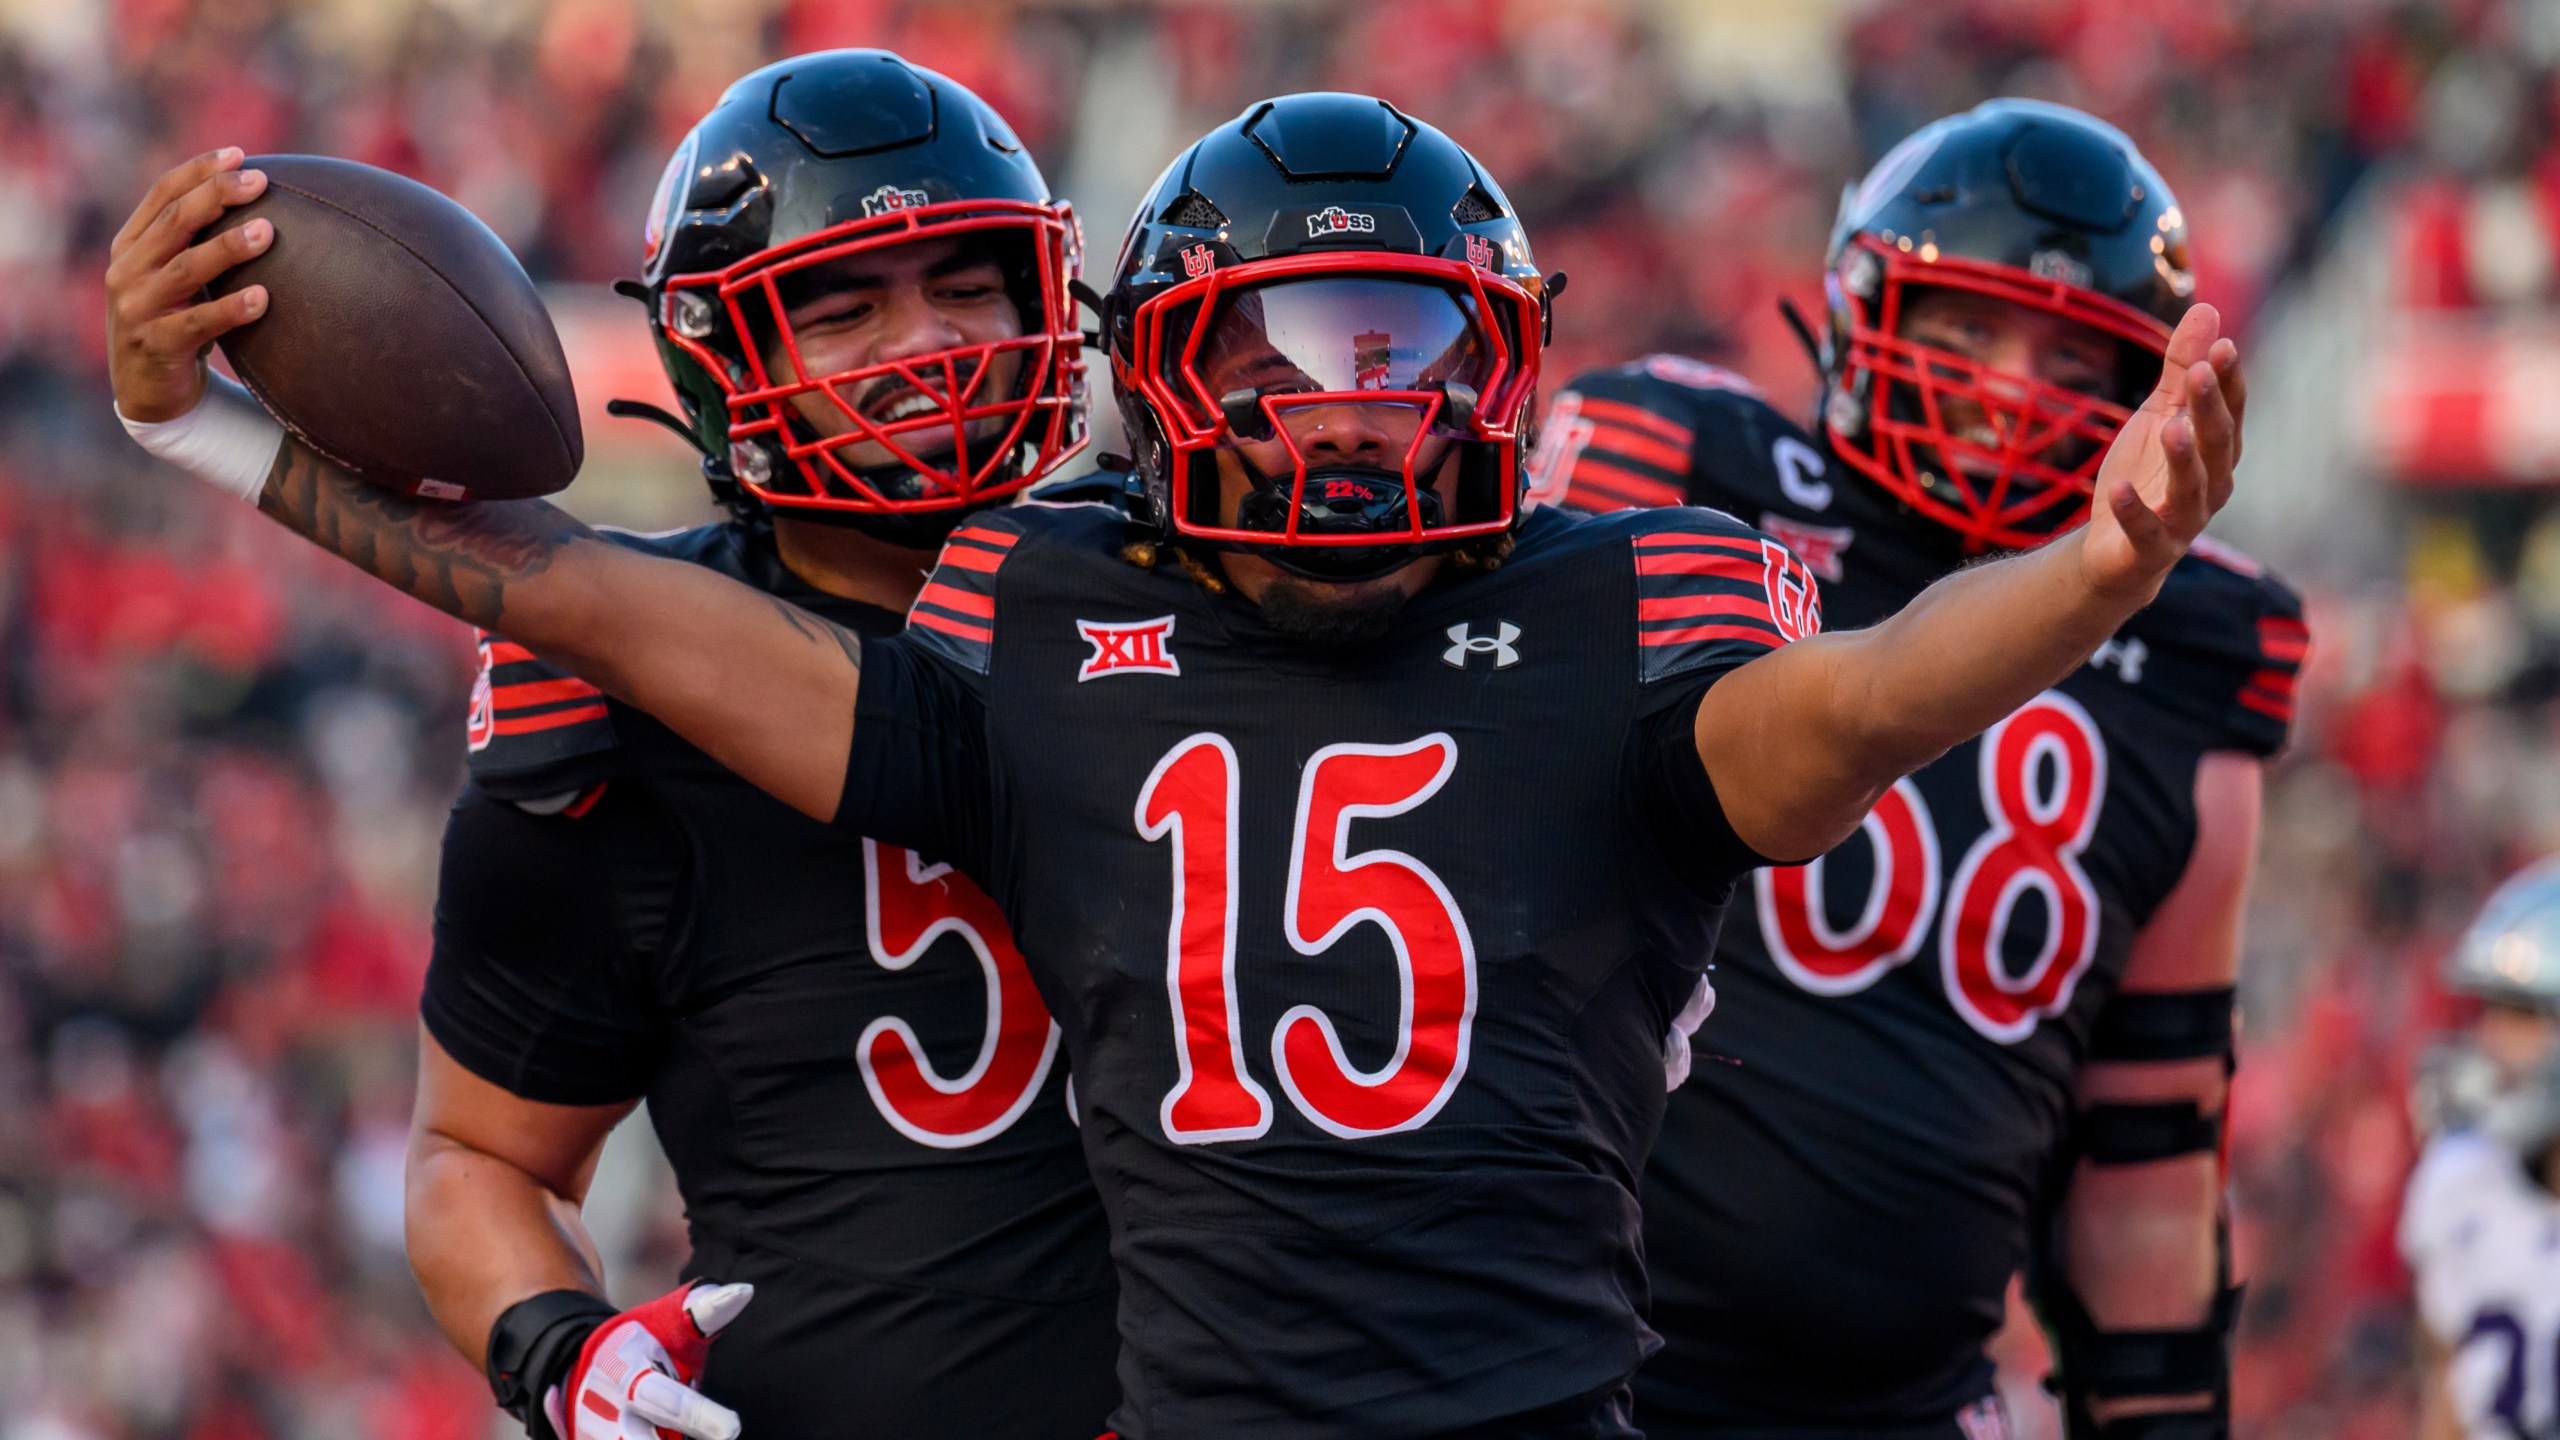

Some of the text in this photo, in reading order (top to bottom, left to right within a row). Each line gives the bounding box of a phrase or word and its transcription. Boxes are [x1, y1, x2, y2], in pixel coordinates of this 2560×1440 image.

[1308, 211, 1375, 237] MUSS
[1325, 480, 1374, 500] 22%
[1773, 437, 1833, 512] C
[1080, 618, 1177, 678] XII
[1135, 732, 1478, 1144] 15
[856, 836, 1080, 1149] 5
